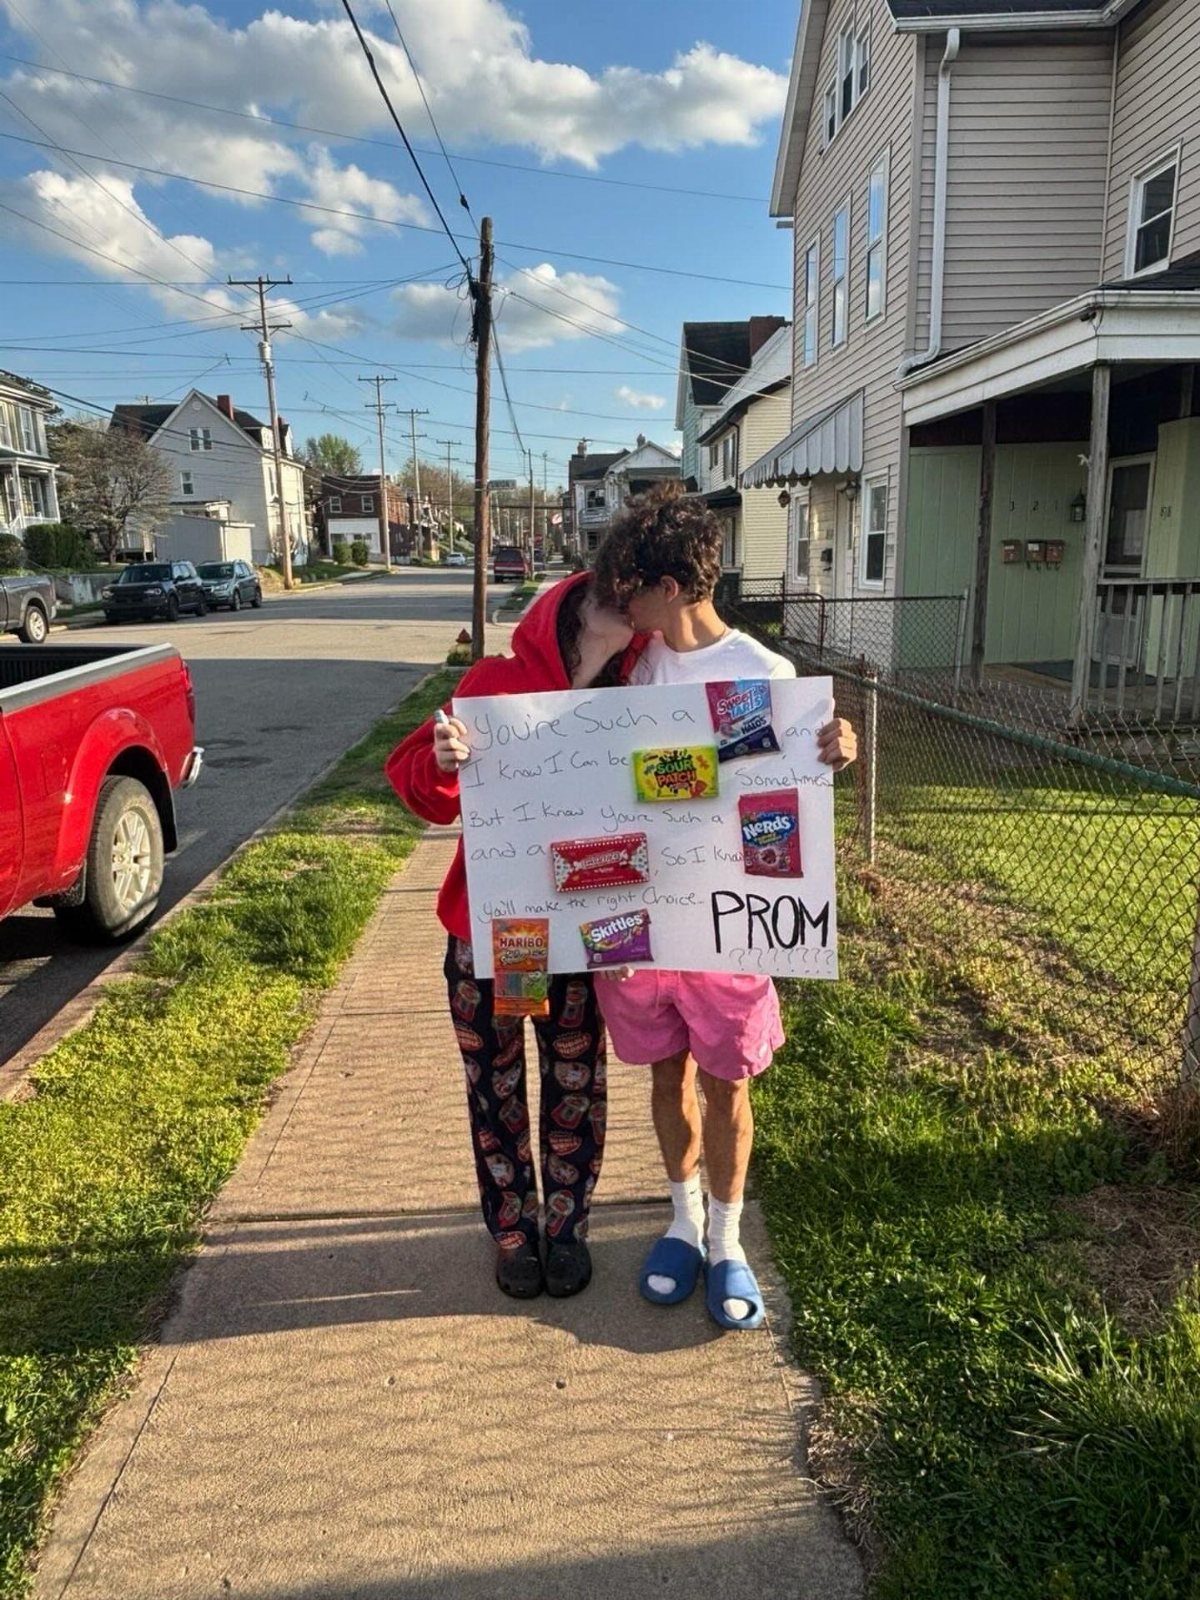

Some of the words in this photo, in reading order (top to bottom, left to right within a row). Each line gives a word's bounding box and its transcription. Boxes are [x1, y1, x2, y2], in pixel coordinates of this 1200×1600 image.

[470, 712, 568, 751] You're
[573, 700, 658, 734] Such
[672, 709, 696, 724] a
[461, 758, 485, 789] I
[544, 750, 564, 774] I
[608, 750, 629, 767] be
[656, 770, 697, 787] PATCH
[657, 760, 693, 775] SOUR
[469, 808, 505, 828] But
[512, 801, 536, 822] I
[711, 814, 724, 825] a
[470, 841, 517, 861] and
[526, 844, 546, 856] a
[661, 846, 687, 866] So
[687, 846, 706, 863] I
[525, 900, 563, 914] make
[566, 897, 588, 909] the
[597, 891, 636, 911] right
[591, 914, 643, 943] Skittles
[711, 890, 830, 954] PROM
[500, 936, 544, 948] HARIBO
